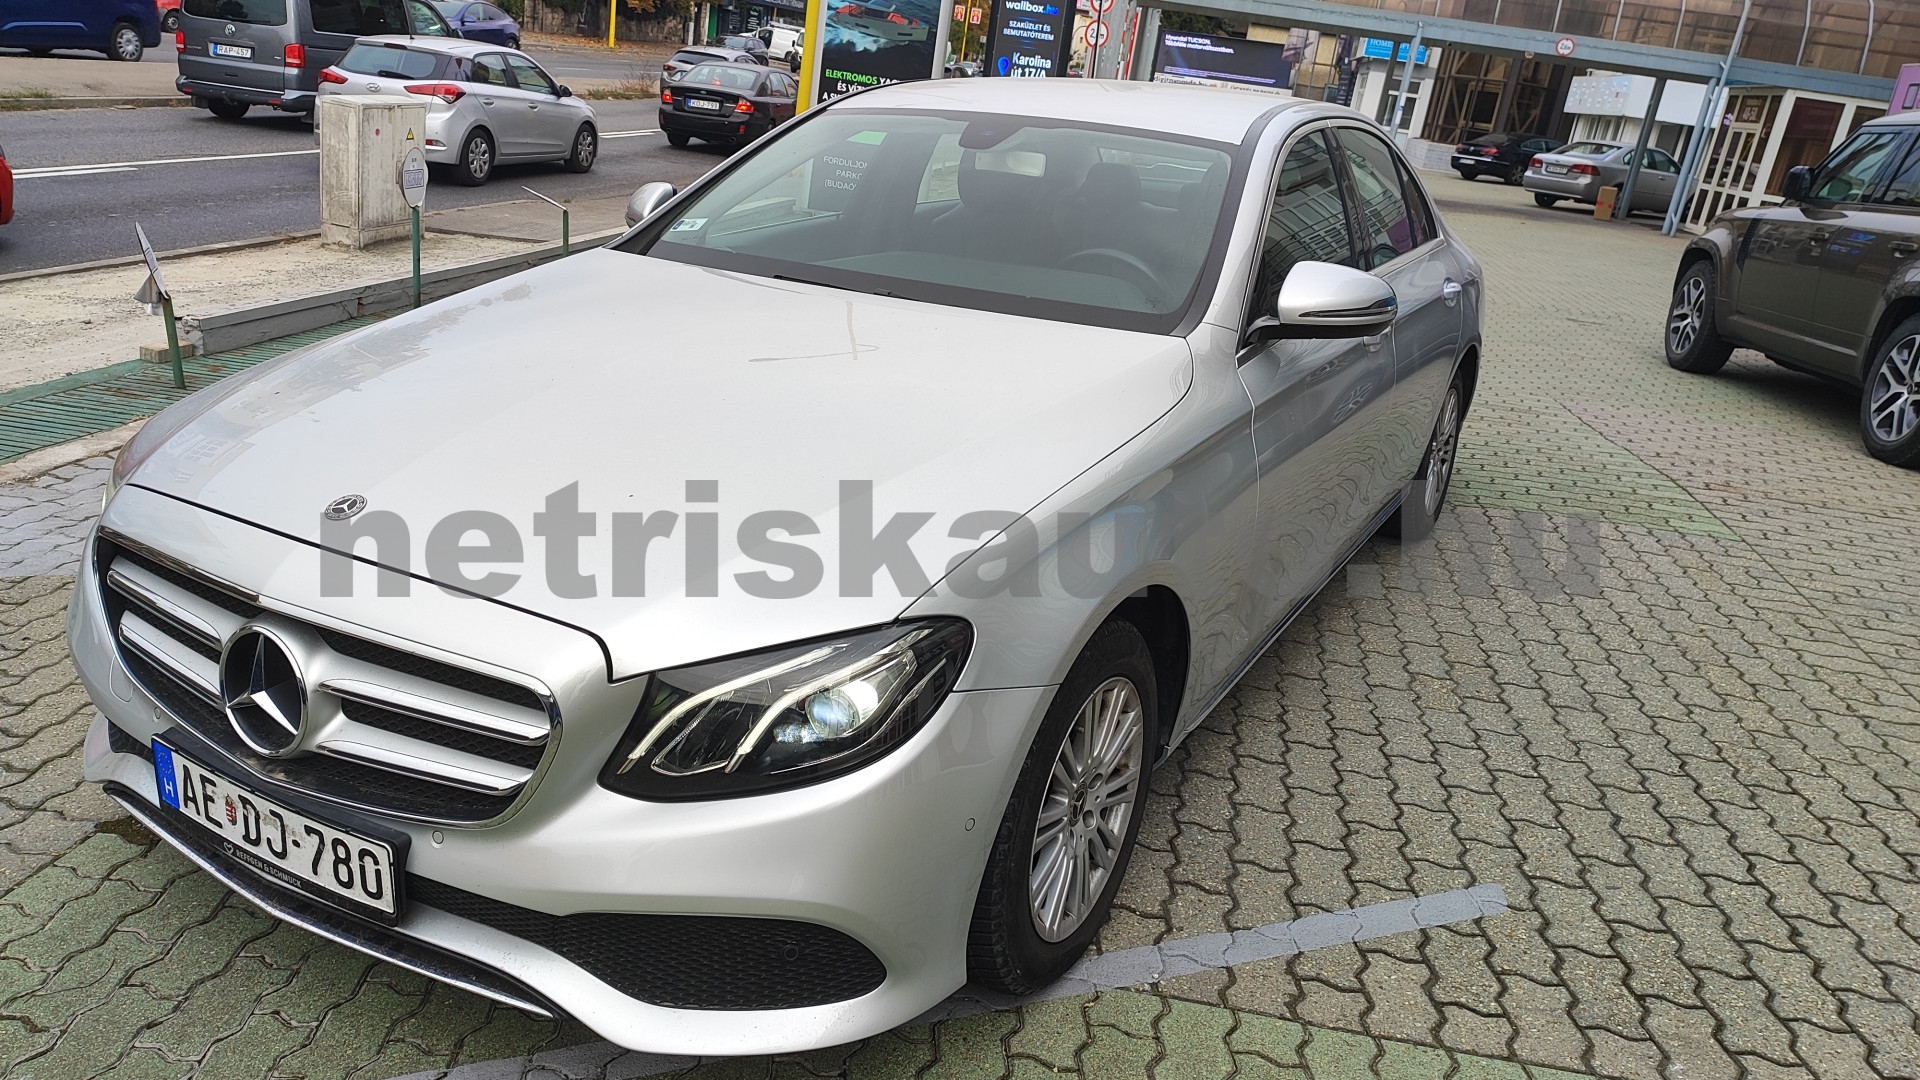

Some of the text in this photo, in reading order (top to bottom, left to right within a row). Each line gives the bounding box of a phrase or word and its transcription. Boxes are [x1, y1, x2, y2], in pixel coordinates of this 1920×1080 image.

[1005, 0, 1059, 16] wallbox.hu
[1008, 20, 1051, 32] SZAKÜZLET ÉS
[1003, 28, 1055, 41] BEMUTATÓTEREM
[1165, 33, 1187, 42] Hyundai
[218, 45, 249, 57] RAP-457
[1012, 51, 1052, 69] Karolina
[825, 68, 878, 85] ELEKTROMOS
[1010, 65, 1022, 78] út
[836, 80, 847, 92] ÉS
[822, 91, 828, 101] A
[164, 776, 175, 798] H
[182, 763, 384, 901] AE DJ-780
[235, 849, 302, 888] REFFGEN & SCHMUCK
